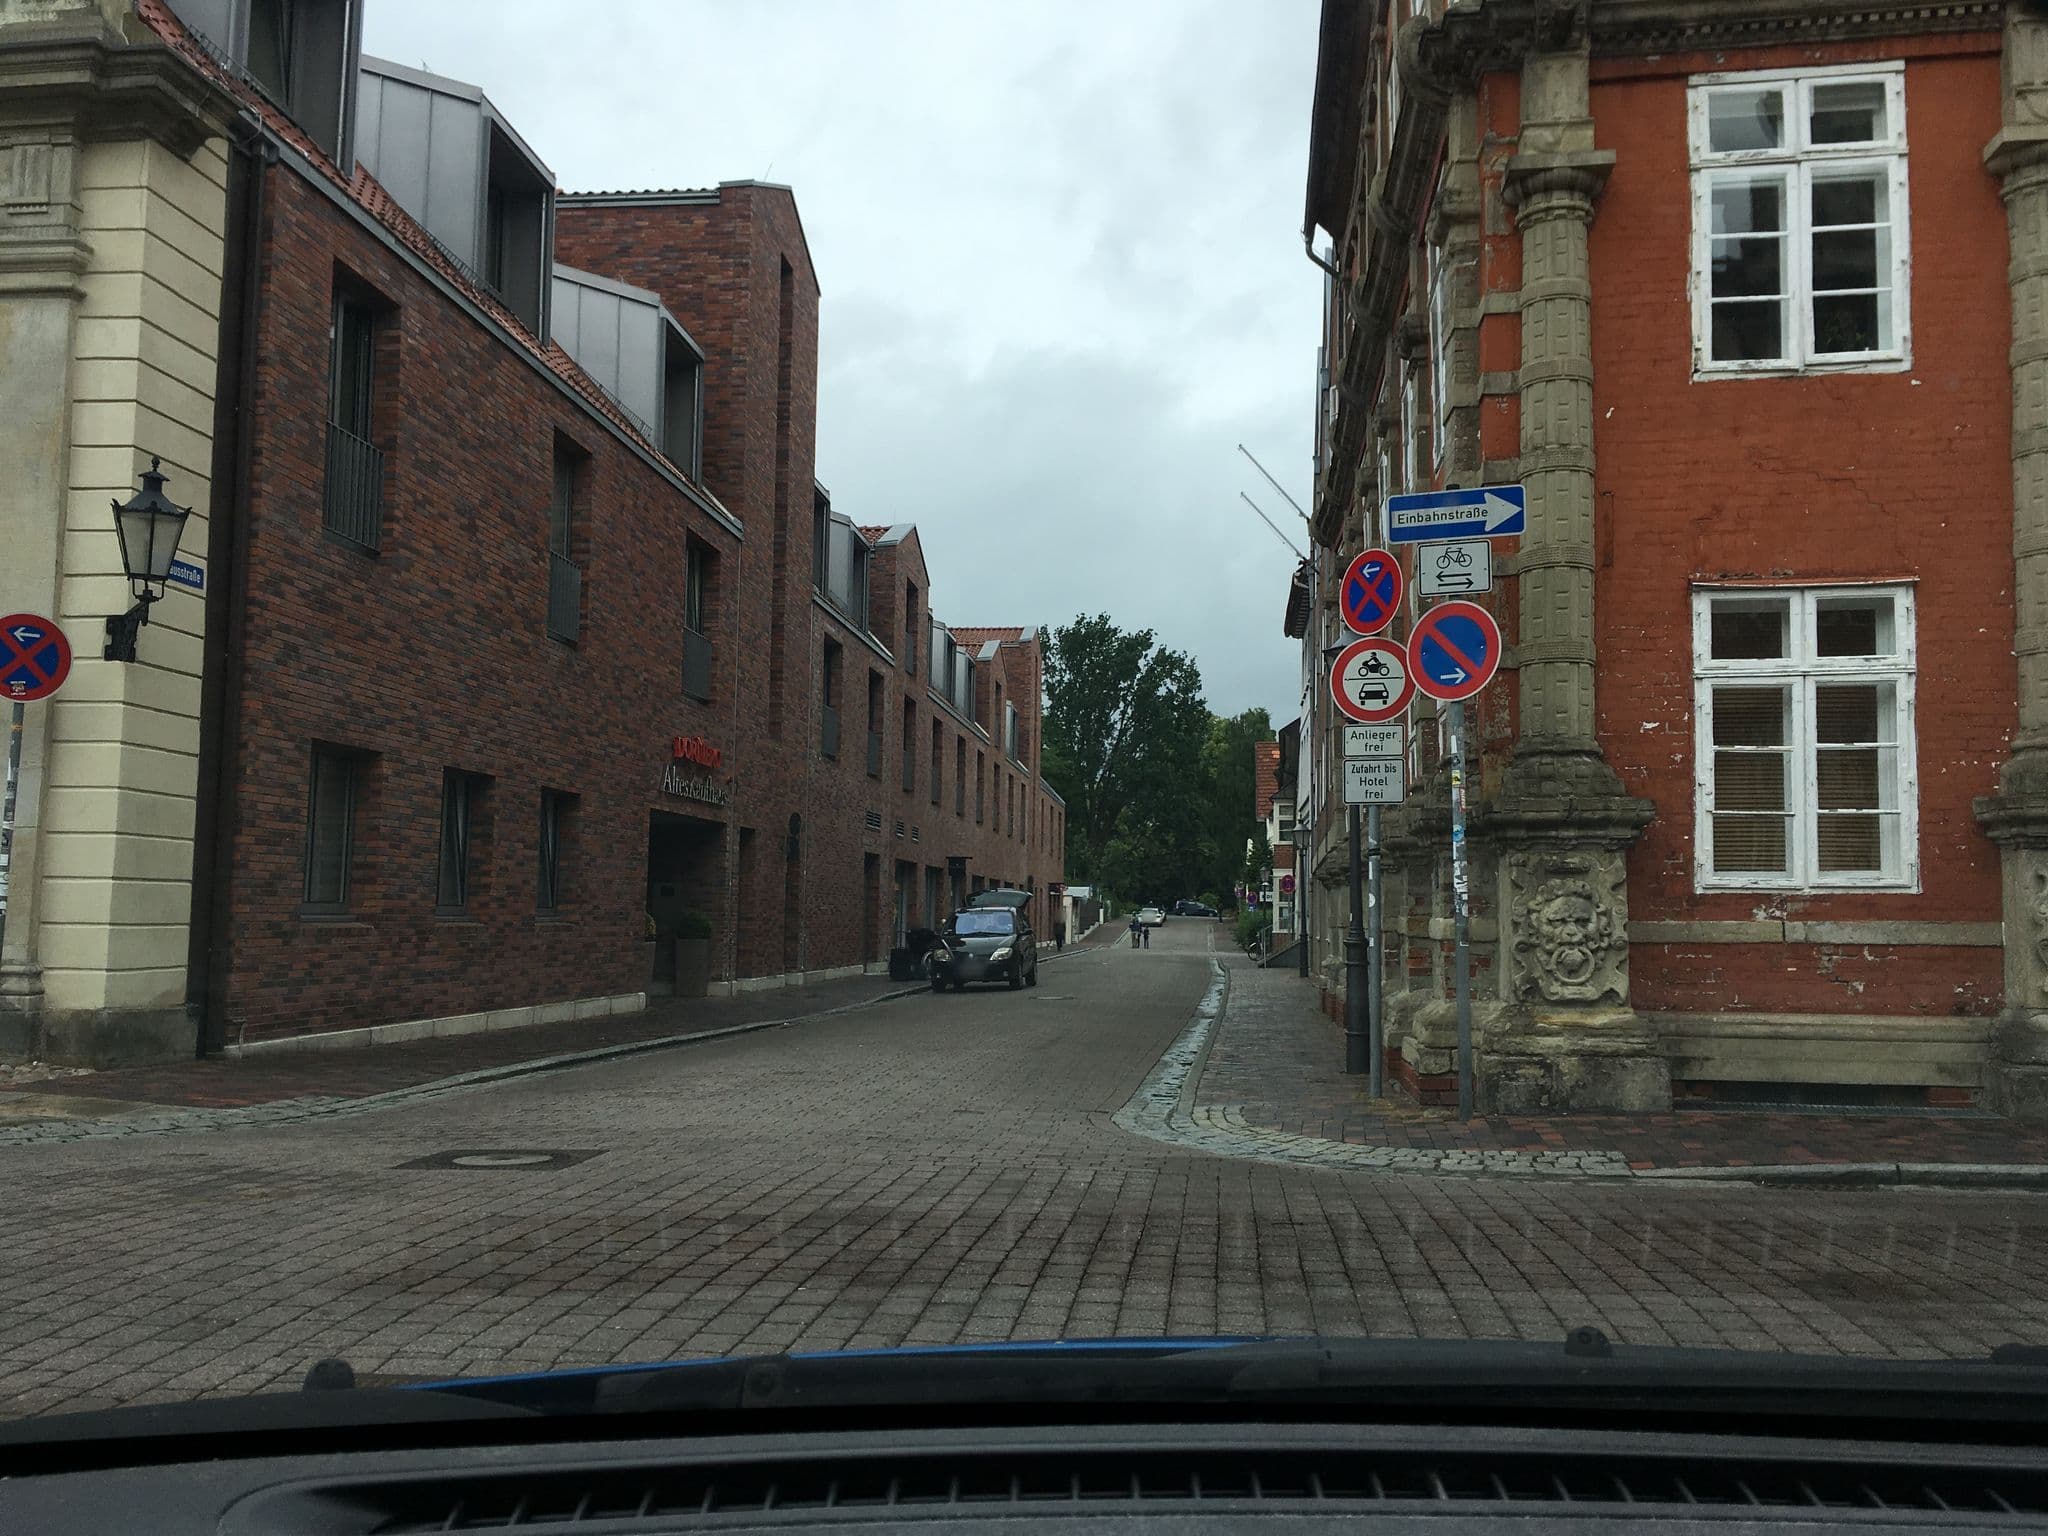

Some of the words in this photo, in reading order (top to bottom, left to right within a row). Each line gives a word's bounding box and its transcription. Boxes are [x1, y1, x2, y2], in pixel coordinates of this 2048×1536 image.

[1397, 507, 1489, 525] Einbahnstraße
[1350, 730, 1397, 742] Anlieger
[1364, 742, 1384, 752] frei
[1351, 763, 1381, 774] Zufahrt
[1384, 763, 1397, 773] bis
[663, 764, 689, 797] Altes
[1359, 776, 1388, 786] Hotel
[1365, 789, 1384, 799] frei
